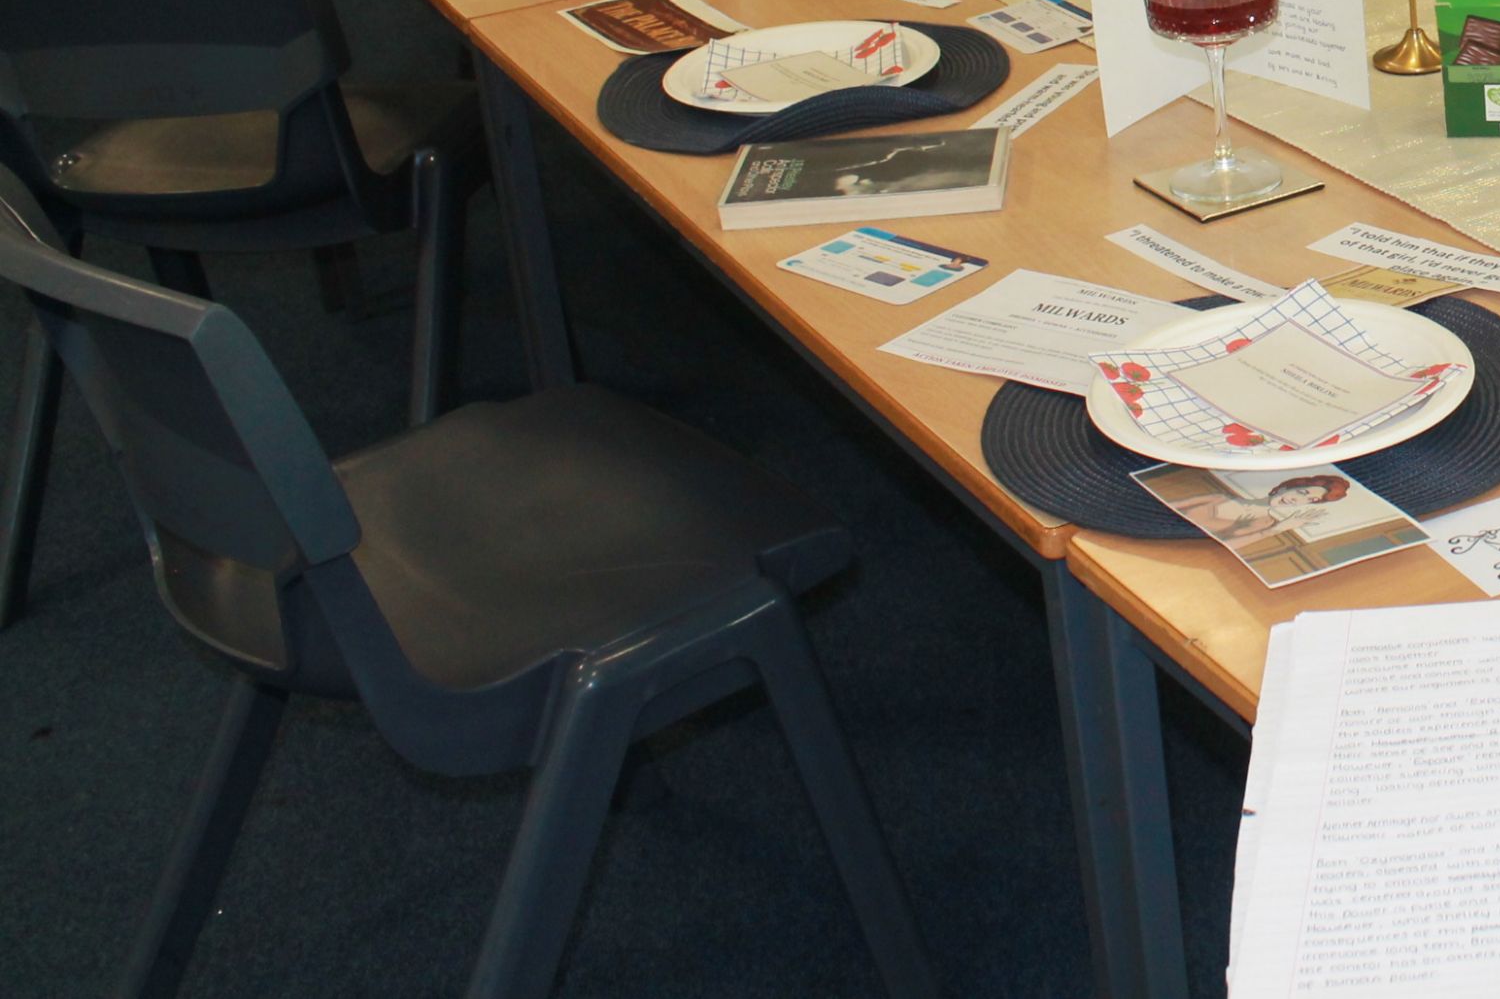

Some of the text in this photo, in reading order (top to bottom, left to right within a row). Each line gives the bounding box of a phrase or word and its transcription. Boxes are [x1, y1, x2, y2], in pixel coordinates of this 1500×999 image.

[1136, 235, 1195, 267] threatened
[1189, 262, 1206, 273] to
[1202, 269, 1236, 287] make
[1340, 239, 1358, 248] of
[1357, 242, 1389, 256] that
[1387, 250, 1418, 267] girl,
[1419, 258, 1440, 270] I'd
[1439, 264, 1486, 279] never
[1360, 230, 1393, 245] told
[1393, 236, 1423, 251] him
[1421, 245, 1454, 260] that
[1455, 252, 1471, 263] if
[1468, 257, 1500, 275] they
[1388, 264, 1430, 279] place
[1077, 288, 1139, 306] MILWARDS
[1031, 302, 1129, 327] MILWARDS
